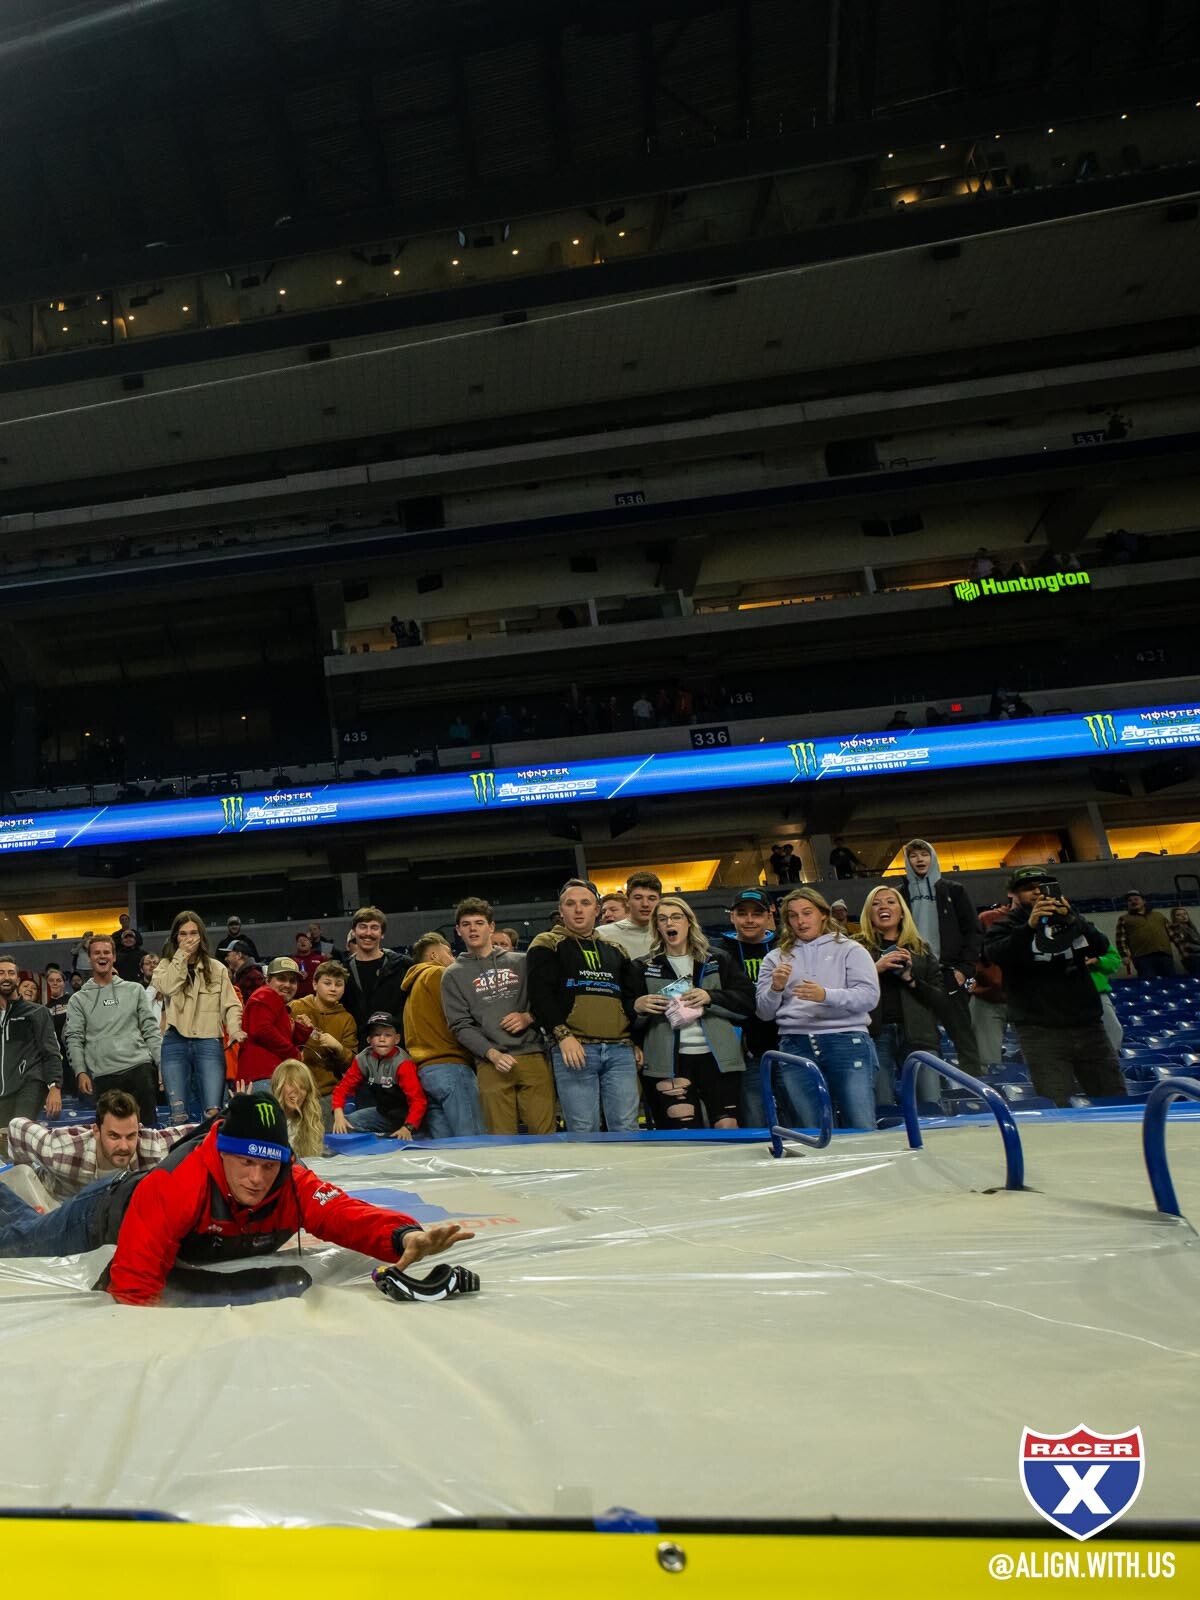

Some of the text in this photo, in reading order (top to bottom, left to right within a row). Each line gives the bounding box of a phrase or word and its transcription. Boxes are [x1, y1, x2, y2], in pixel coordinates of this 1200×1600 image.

[981, 569, 1090, 597] Huntington
[1141, 709, 1200, 720] MONSTER
[344, 731, 368, 743] 435
[693, 731, 728, 746] 336
[840, 737, 897, 748] MONSTER
[821, 748, 928, 767] SUPERCROSS
[846, 761, 907, 772] CHAMPIONSHIP
[517, 768, 569, 778] MONSTER
[264, 792, 312, 802] MONSTER
[521, 791, 577, 801] CHAMPIONSHIP
[266, 815, 318, 825] CHAMPIONSHIP
[258, 1146, 282, 1159] YAMAHA
